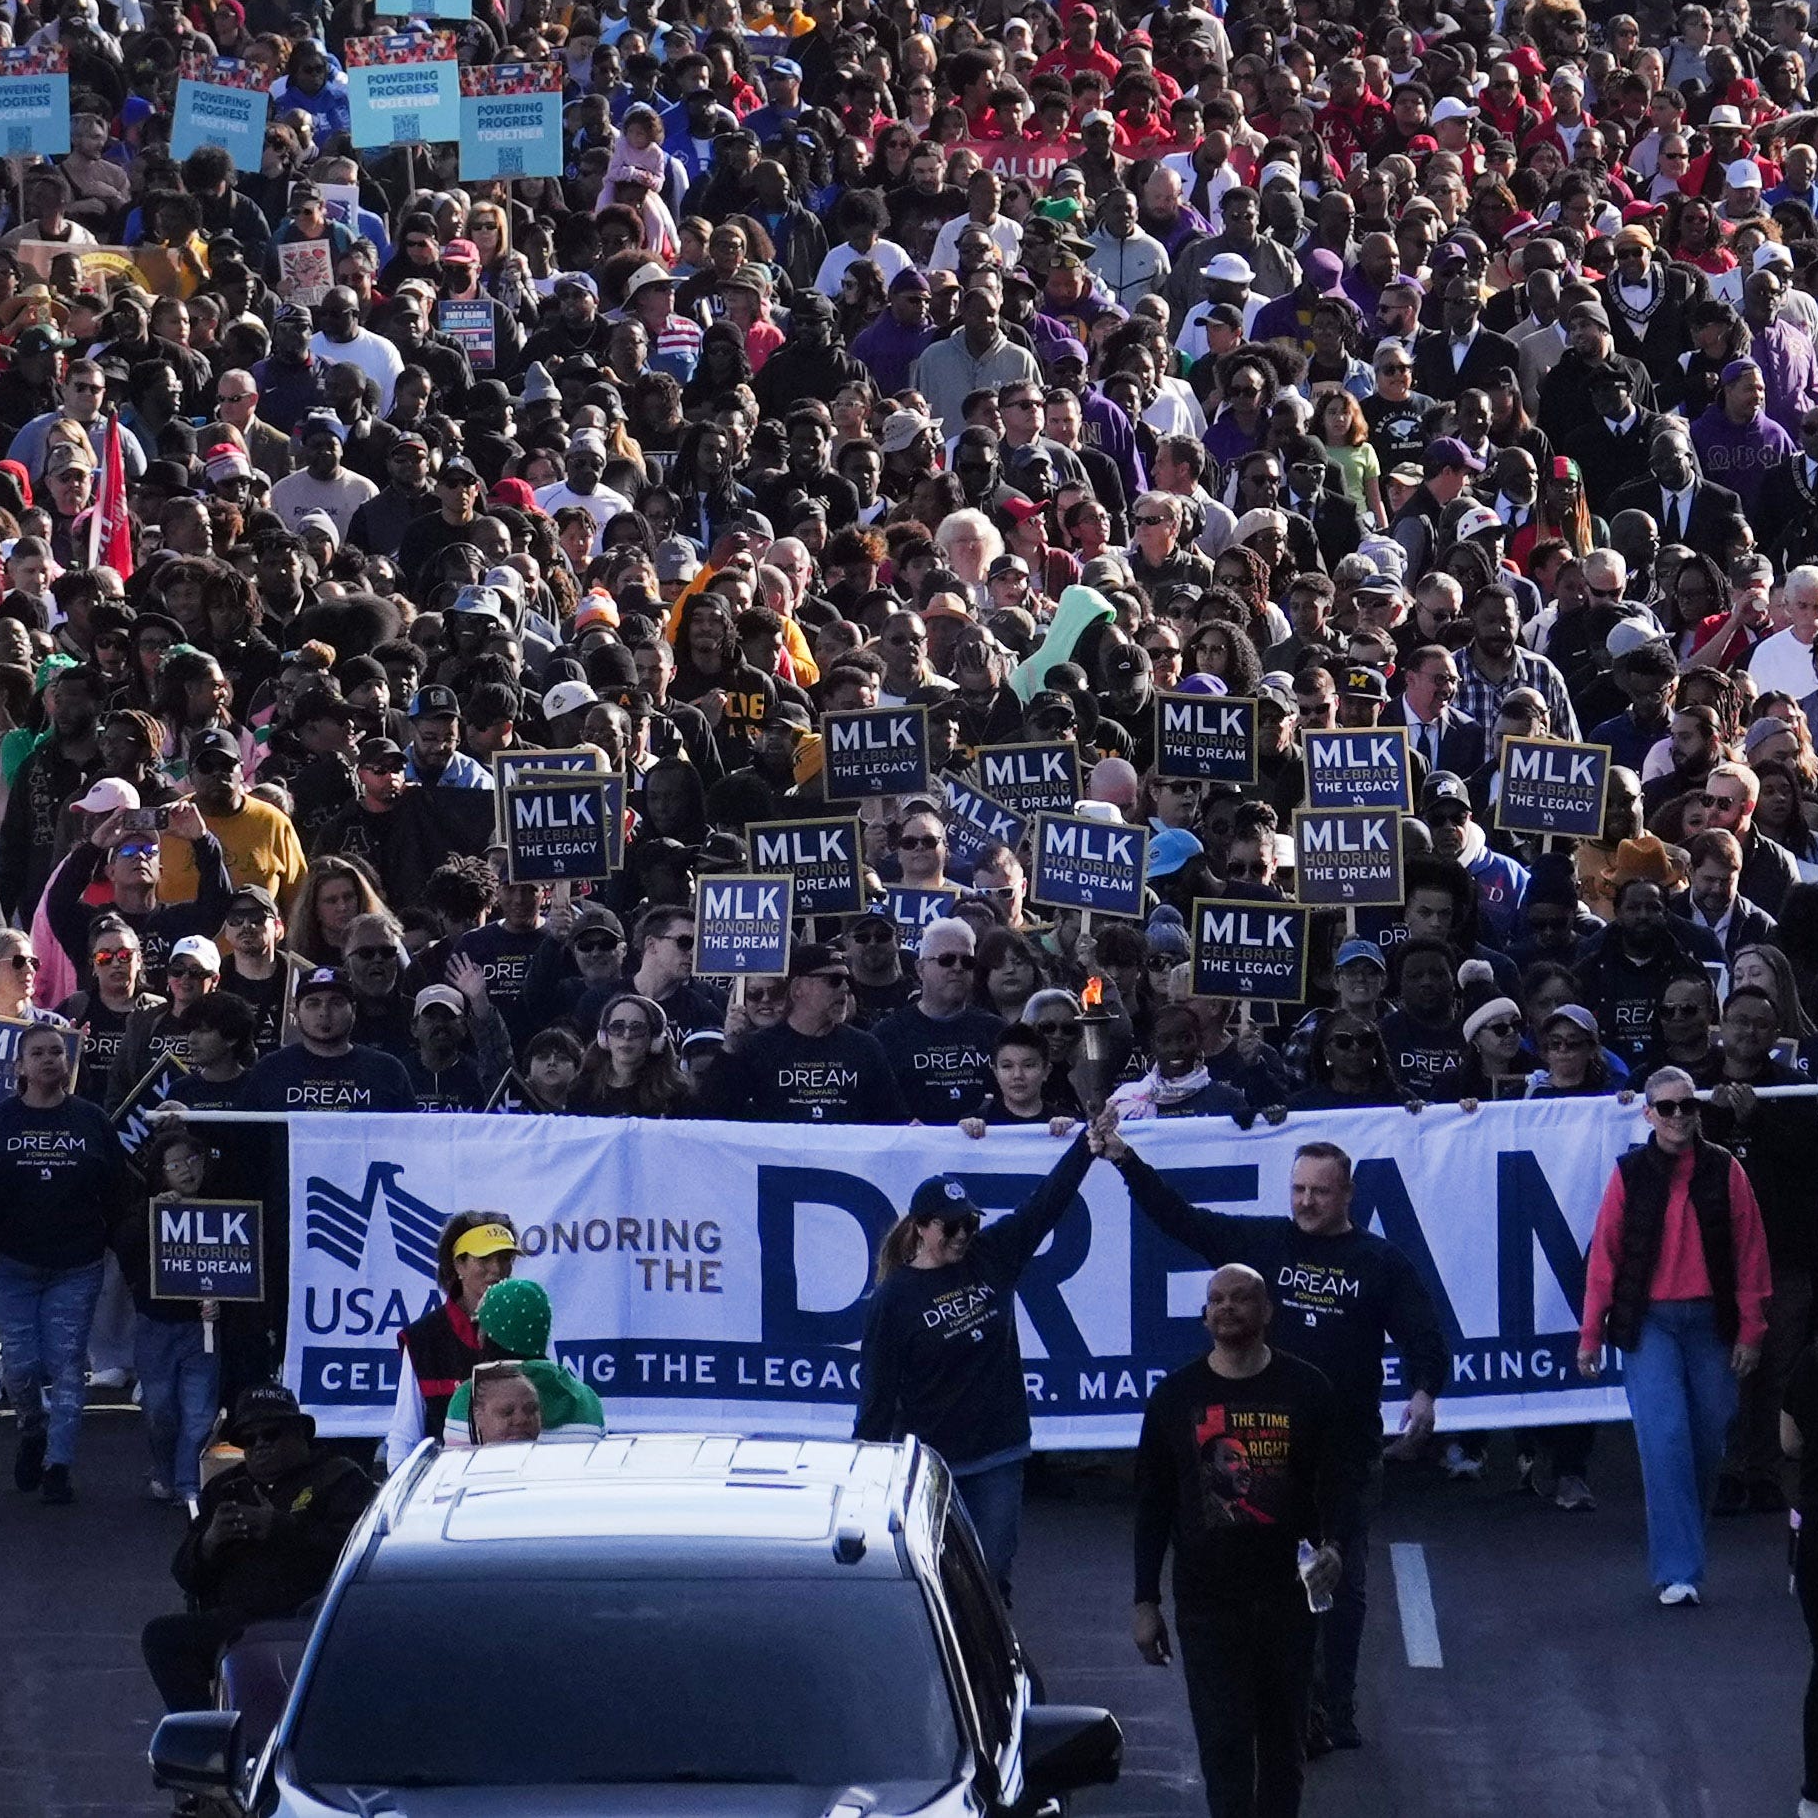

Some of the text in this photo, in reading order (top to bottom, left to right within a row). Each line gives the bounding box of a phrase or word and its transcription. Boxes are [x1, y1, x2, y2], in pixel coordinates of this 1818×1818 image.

[367, 71, 438, 85] POWERING
[369, 83, 439, 97] PROGRESS
[192, 90, 252, 109] POWERING
[191, 103, 250, 121] PROGRESS
[477, 103, 544, 115] POWERING
[478, 115, 543, 129] PROGRESS
[1164, 703, 1246, 737] MLK
[832, 716, 916, 752] MLK
[1164, 733, 1246, 749] HONORING
[832, 749, 917, 764] CELEBRATE
[1165, 745, 1246, 761] THE DREAM
[1312, 737, 1398, 768] MLK
[834, 761, 917, 776] THE LEGACY
[986, 751, 1070, 786] MLK
[1315, 768, 1399, 782] CELEBRATE
[1510, 749, 1597, 786] MLK
[1316, 780, 1400, 793] THE LEGACY
[1509, 781, 1594, 800] CELEBRATE
[1021, 795, 1072, 808] DREAM
[1508, 794, 1593, 812] THE LEGACY
[515, 794, 595, 829] MLK
[945, 781, 1018, 843] MLK
[517, 829, 597, 842] CELEBRATE
[1045, 822, 1134, 866] MLK
[1303, 818, 1390, 852] MLK
[518, 842, 597, 857] THE LEGACY
[757, 829, 849, 866] MLK
[1044, 856, 1134, 878] HONORING
[1304, 852, 1391, 867] HONORING
[1044, 868, 1133, 892] THE DREAM
[1305, 867, 1391, 880] THE DREAM
[796, 876, 851, 891] DREAM
[705, 887, 780, 920] MLK
[704, 920, 780, 934] HONORING
[1202, 910, 1294, 949] MLK
[704, 936, 779, 949] THE DREAM
[1201, 945, 1294, 963] CELEBRATE
[1202, 959, 1293, 977] THE LEGACY
[914, 1053, 991, 1069] DREAM
[779, 1070, 858, 1089] DREAM
[286, 1087, 371, 1105] DREAM
[7, 1137, 86, 1152] DREAM
[161, 1210, 250, 1245] MLK
[518, 1218, 723, 1257] ONORING
[162, 1244, 251, 1260] HONORING
[162, 1259, 252, 1274] THE DREAM
[636, 1257, 723, 1293] THE
[1277, 1266, 1359, 1299] DREAM
[923, 1284, 995, 1329] DREAM
[636, 1353, 716, 1384] THE
[1024, 1372, 1058, 1401] R.
[1454, 1348, 1567, 1382] KING,
[1231, 1413, 1290, 1428] THE TIME
[1249, 1441, 1290, 1457] RIGHT
